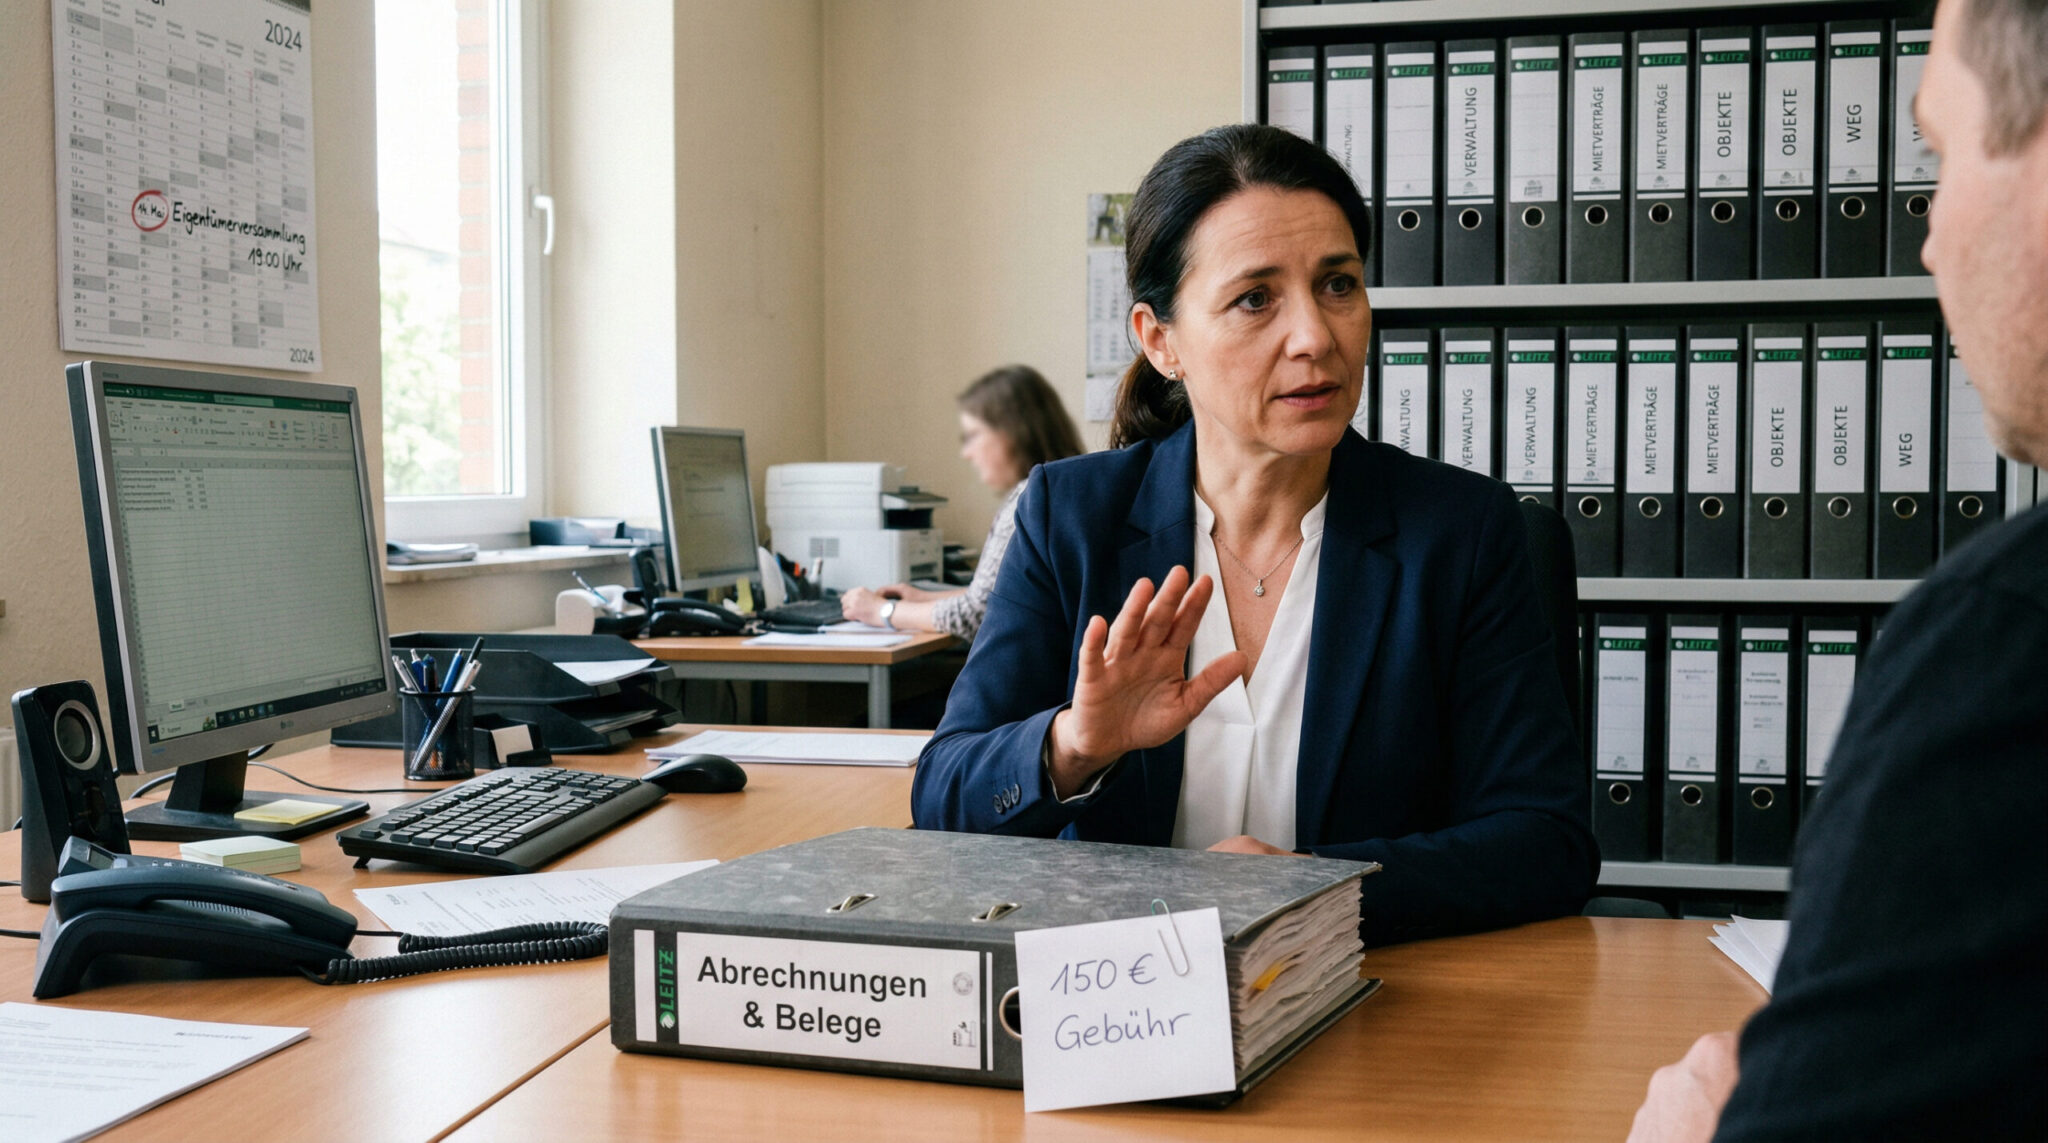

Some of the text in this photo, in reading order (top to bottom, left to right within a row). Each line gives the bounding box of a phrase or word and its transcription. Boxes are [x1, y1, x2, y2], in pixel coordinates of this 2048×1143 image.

[265, 19, 303, 52] 2024
[1714, 52, 1745, 63] LEITZ
[1780, 49, 1811, 61] LEITZ
[1844, 45, 1876, 57] LEITZ
[1523, 59, 1555, 71] LEITZ
[1587, 56, 1619, 68] LEITZ
[1651, 54, 1683, 66] LEITZ
[1280, 71, 1310, 81] LEITZ
[1339, 68, 1368, 79] LEITZ
[1399, 65, 1429, 76] LEITZ
[1459, 64, 1490, 75] LEITZ
[1591, 86, 1605, 172] MIETVERTRÄGE
[1655, 83, 1669, 170] MIETVERTRÄGE
[1717, 91, 1732, 158] OBJEKTE
[1782, 88, 1798, 156] OBJEKTE
[1847, 104, 1862, 143] WEG
[1465, 87, 1478, 177] VERWALTUNG
[173, 201, 306, 255] Eigentümerversammlung
[282, 253, 302, 272] Uhr
[289, 347, 314, 363] 2024
[1394, 354, 1423, 364] LEITZ
[1457, 353, 1487, 363] LEITZ
[1519, 352, 1549, 363] LEITZ
[1581, 351, 1611, 362] LEITZ
[1640, 351, 1672, 362] LEITZ
[1702, 350, 1732, 361] LEITZ
[1766, 350, 1797, 361] LEITZ
[1830, 349, 1861, 360] LEITZ
[1895, 348, 1927, 359] LEITZ
[1462, 388, 1473, 468] VERWALTUNG
[1525, 387, 1537, 467] VERWALTUNG
[1586, 384, 1598, 468] MIETVERTRÄGE
[1644, 386, 1657, 475] MIETVERTRÄGE
[1706, 384, 1719, 474] MIETVERTRÄGE
[1771, 407, 1785, 468] OBJEKTE
[1834, 405, 1848, 466] OBJEKTE
[1899, 433, 1913, 467] WEG
[1611, 640, 1641, 650] LEITZ
[1684, 640, 1713, 650] LEITZ
[1754, 641, 1784, 652] LEITZ
[1821, 643, 1852, 654] LEITZ
[659, 950, 674, 1010] LEITZ
[697, 956, 927, 1002] Abrechnungen
[1051, 953, 1157, 995] 150 €
[744, 1001, 881, 1042] & Belege
[1055, 1007, 1191, 1050] Gebühr
